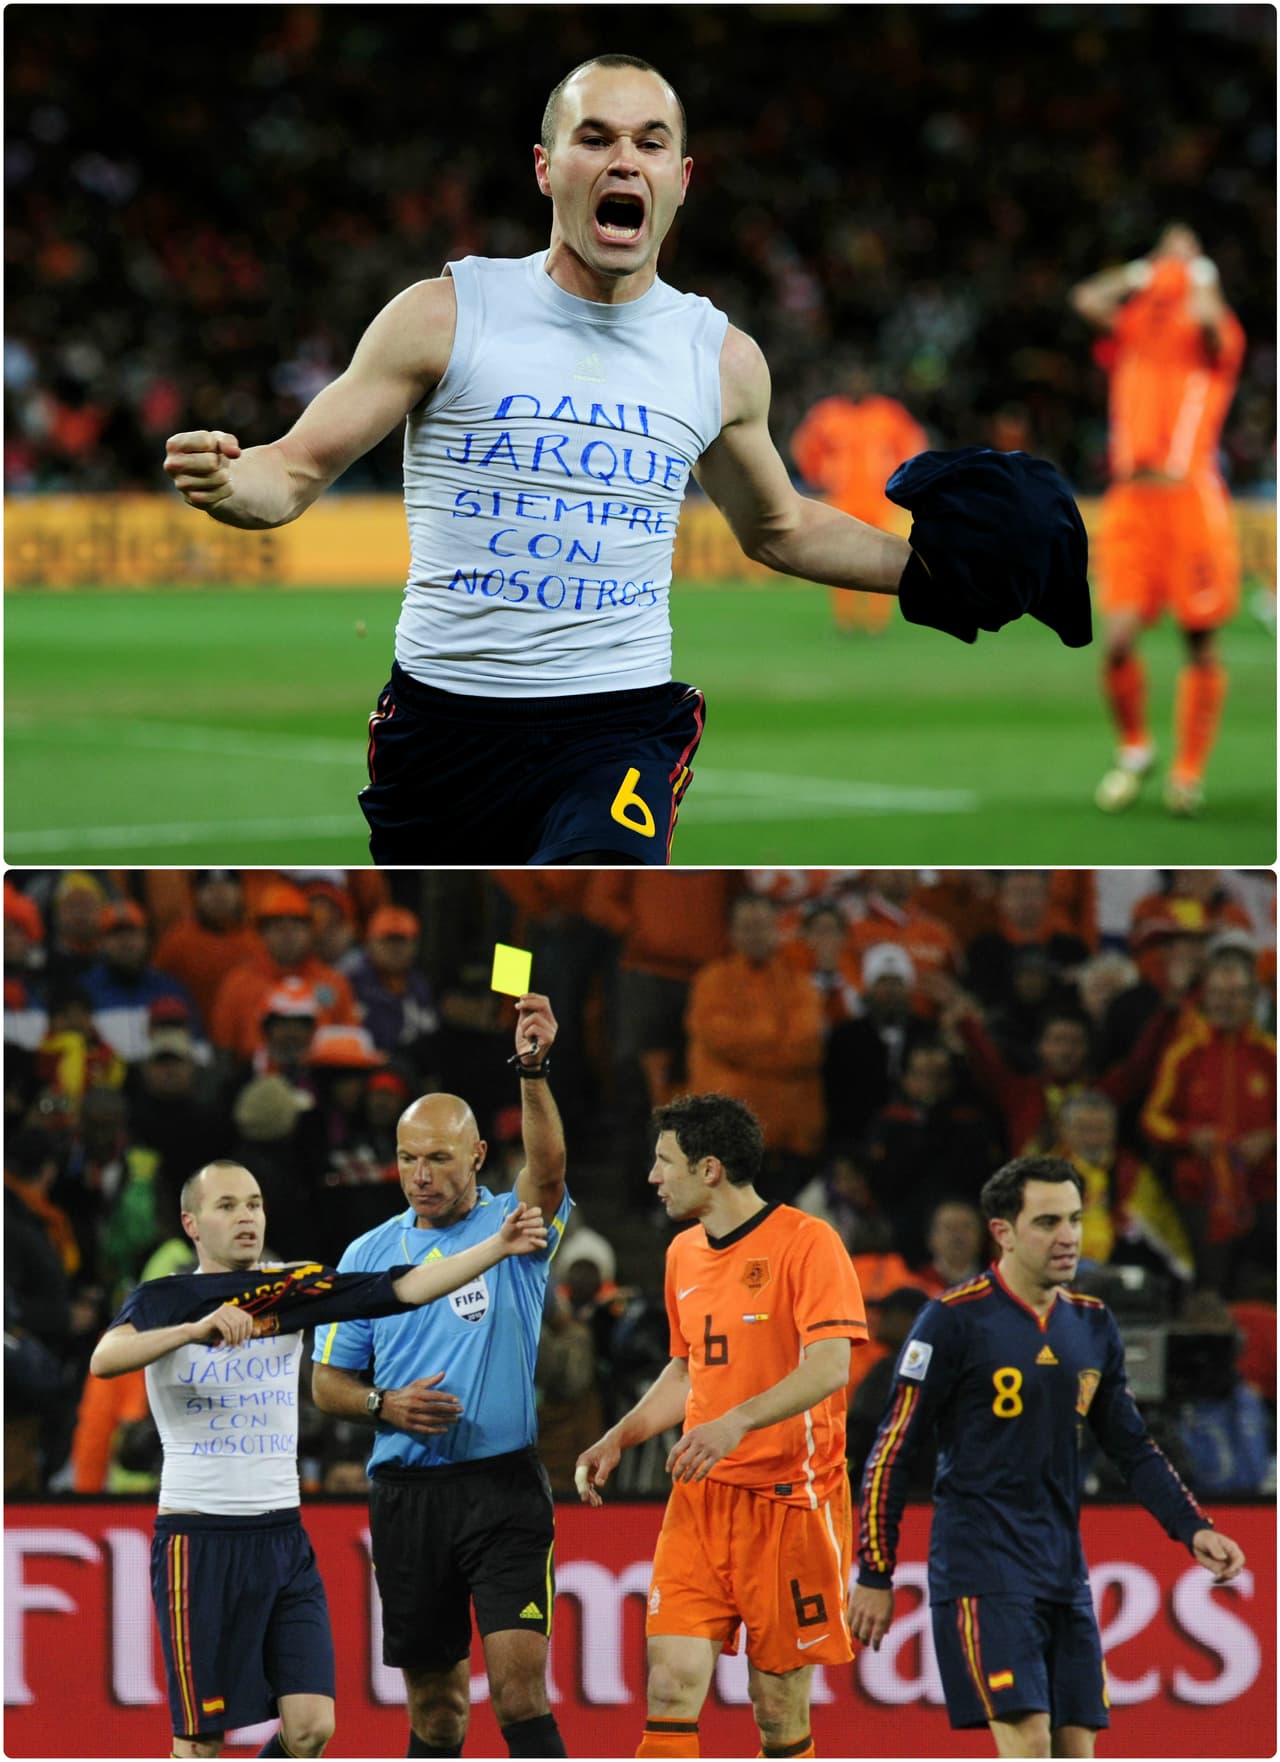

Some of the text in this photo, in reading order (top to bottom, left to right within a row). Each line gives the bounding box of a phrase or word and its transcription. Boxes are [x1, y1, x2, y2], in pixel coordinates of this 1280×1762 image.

[446, 432, 687, 492] JARQUE
[452, 489, 671, 534] SIEMPRE
[488, 528, 602, 563] CON
[448, 568, 658, 611] NOSOTROS
[611, 767, 656, 838] 6
[455, 1291, 485, 1307] FIFA
[704, 1314, 729, 1367] 6
[178, 1353, 295, 1385] JARQUE
[186, 1390, 295, 1416] SIEMPRE
[992, 1366, 1024, 1419] 8
[210, 1412, 268, 1431] CON
[191, 1433, 296, 1456] NOSOTROS
[790, 1578, 829, 1628] 6
[4, 1528, 282, 1746] Fl
